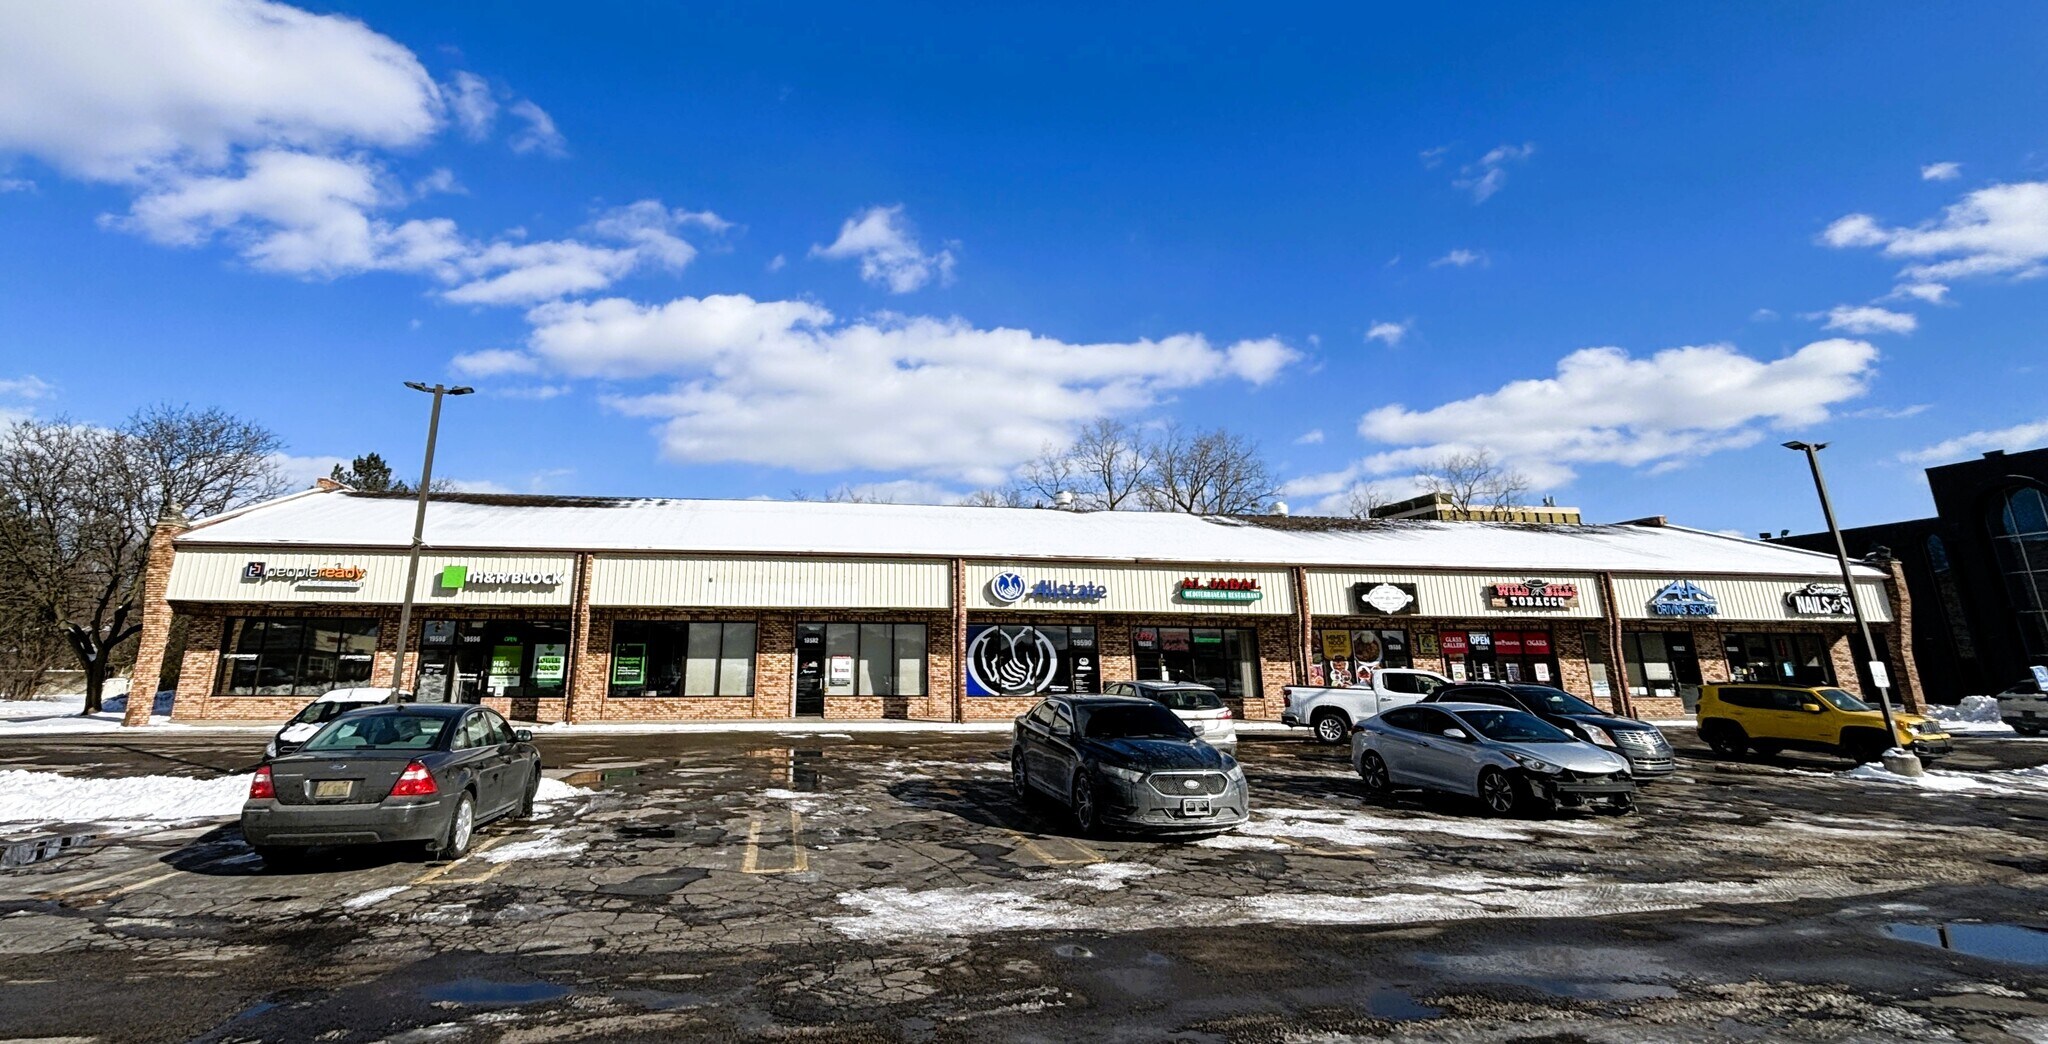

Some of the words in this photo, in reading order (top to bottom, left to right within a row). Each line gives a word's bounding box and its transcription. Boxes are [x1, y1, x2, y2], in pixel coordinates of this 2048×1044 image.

[265, 563, 365, 580] peopleready
[466, 571, 508, 584] H&R
[509, 571, 562, 584] BLOCK
[1031, 579, 1107, 599] Allstate
[1182, 577, 1204, 589] AL
[1496, 583, 1530, 597] WILD
[1510, 596, 1565, 606] TOBACCO
[1795, 595, 1832, 614] NAILS
[1832, 599, 1842, 611] &
[1656, 604, 1688, 615] DRIVING
[1442, 641, 1467, 649] GALLERY
[1469, 636, 1491, 646] OPEN
[491, 666, 519, 674] BLOCK
